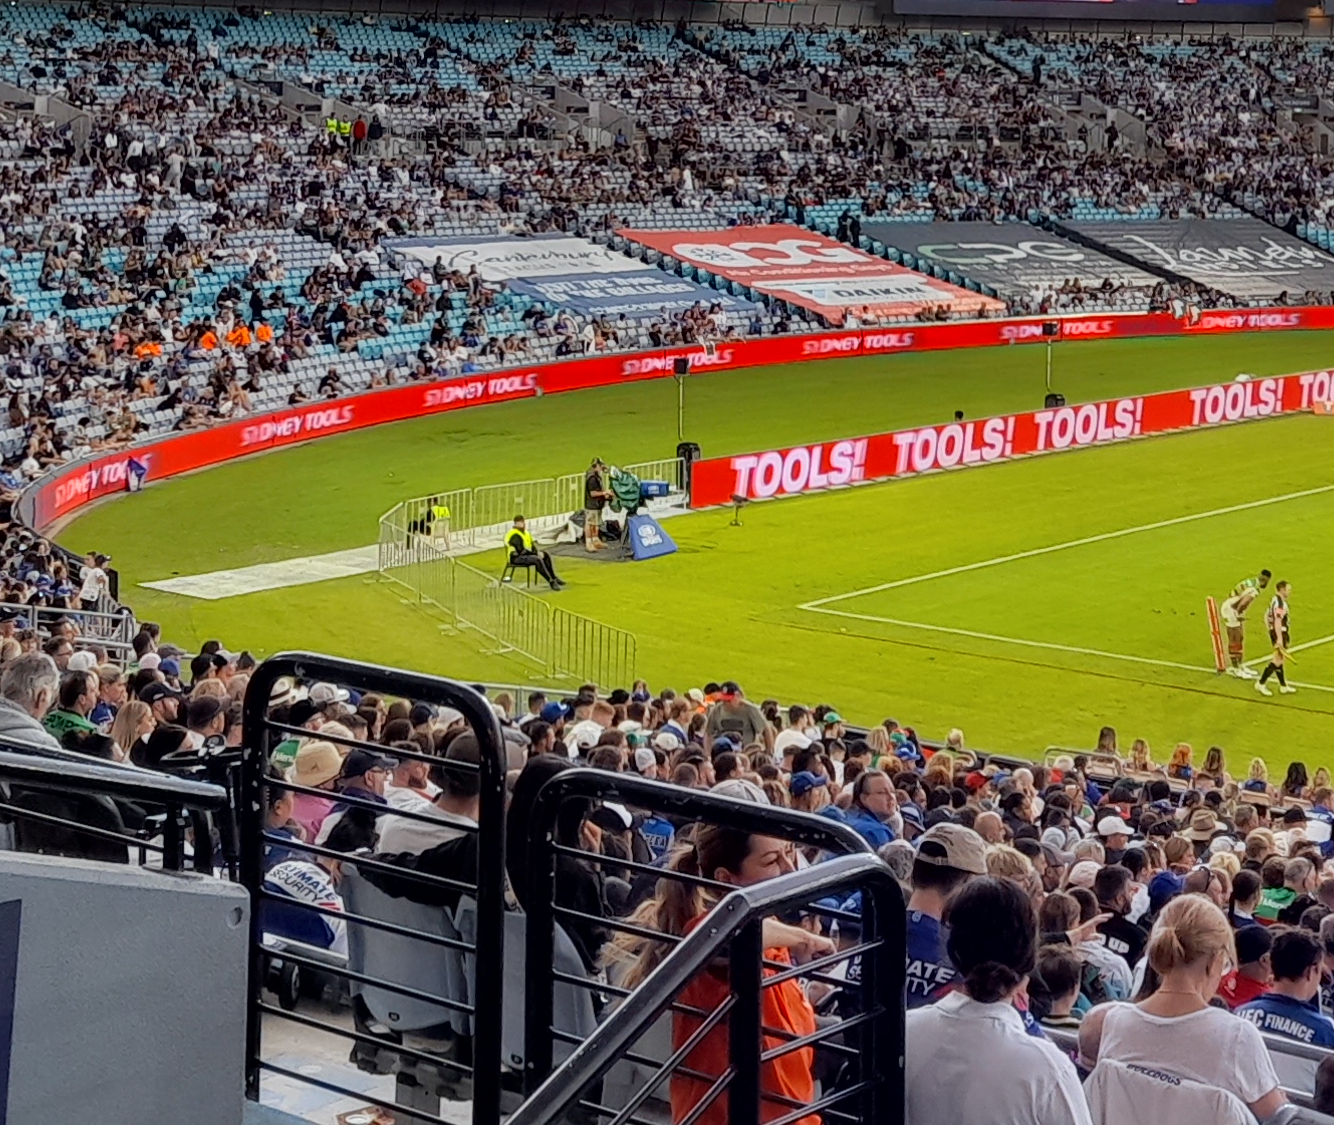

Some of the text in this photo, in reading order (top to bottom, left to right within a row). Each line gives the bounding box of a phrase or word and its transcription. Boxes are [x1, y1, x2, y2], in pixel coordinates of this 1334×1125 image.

[834, 283, 927, 300] DAIKIN
[1062, 320, 1114, 334] TOOLS
[1248, 313, 1302, 328] TOOLS
[863, 332, 915, 349] TOOLS
[487, 373, 539, 396] TOOLS
[304, 405, 355, 432] TOOLS
[730, 438, 868, 498] TOOLS!
[894, 417, 1016, 474] TOOLS!
[1034, 398, 1145, 451] TOOLS!
[1189, 378, 1283, 425] TOOLS!
[1264, 1011, 1316, 1043] FINANCE
[1125, 1063, 1182, 1086] BULLDOGS
